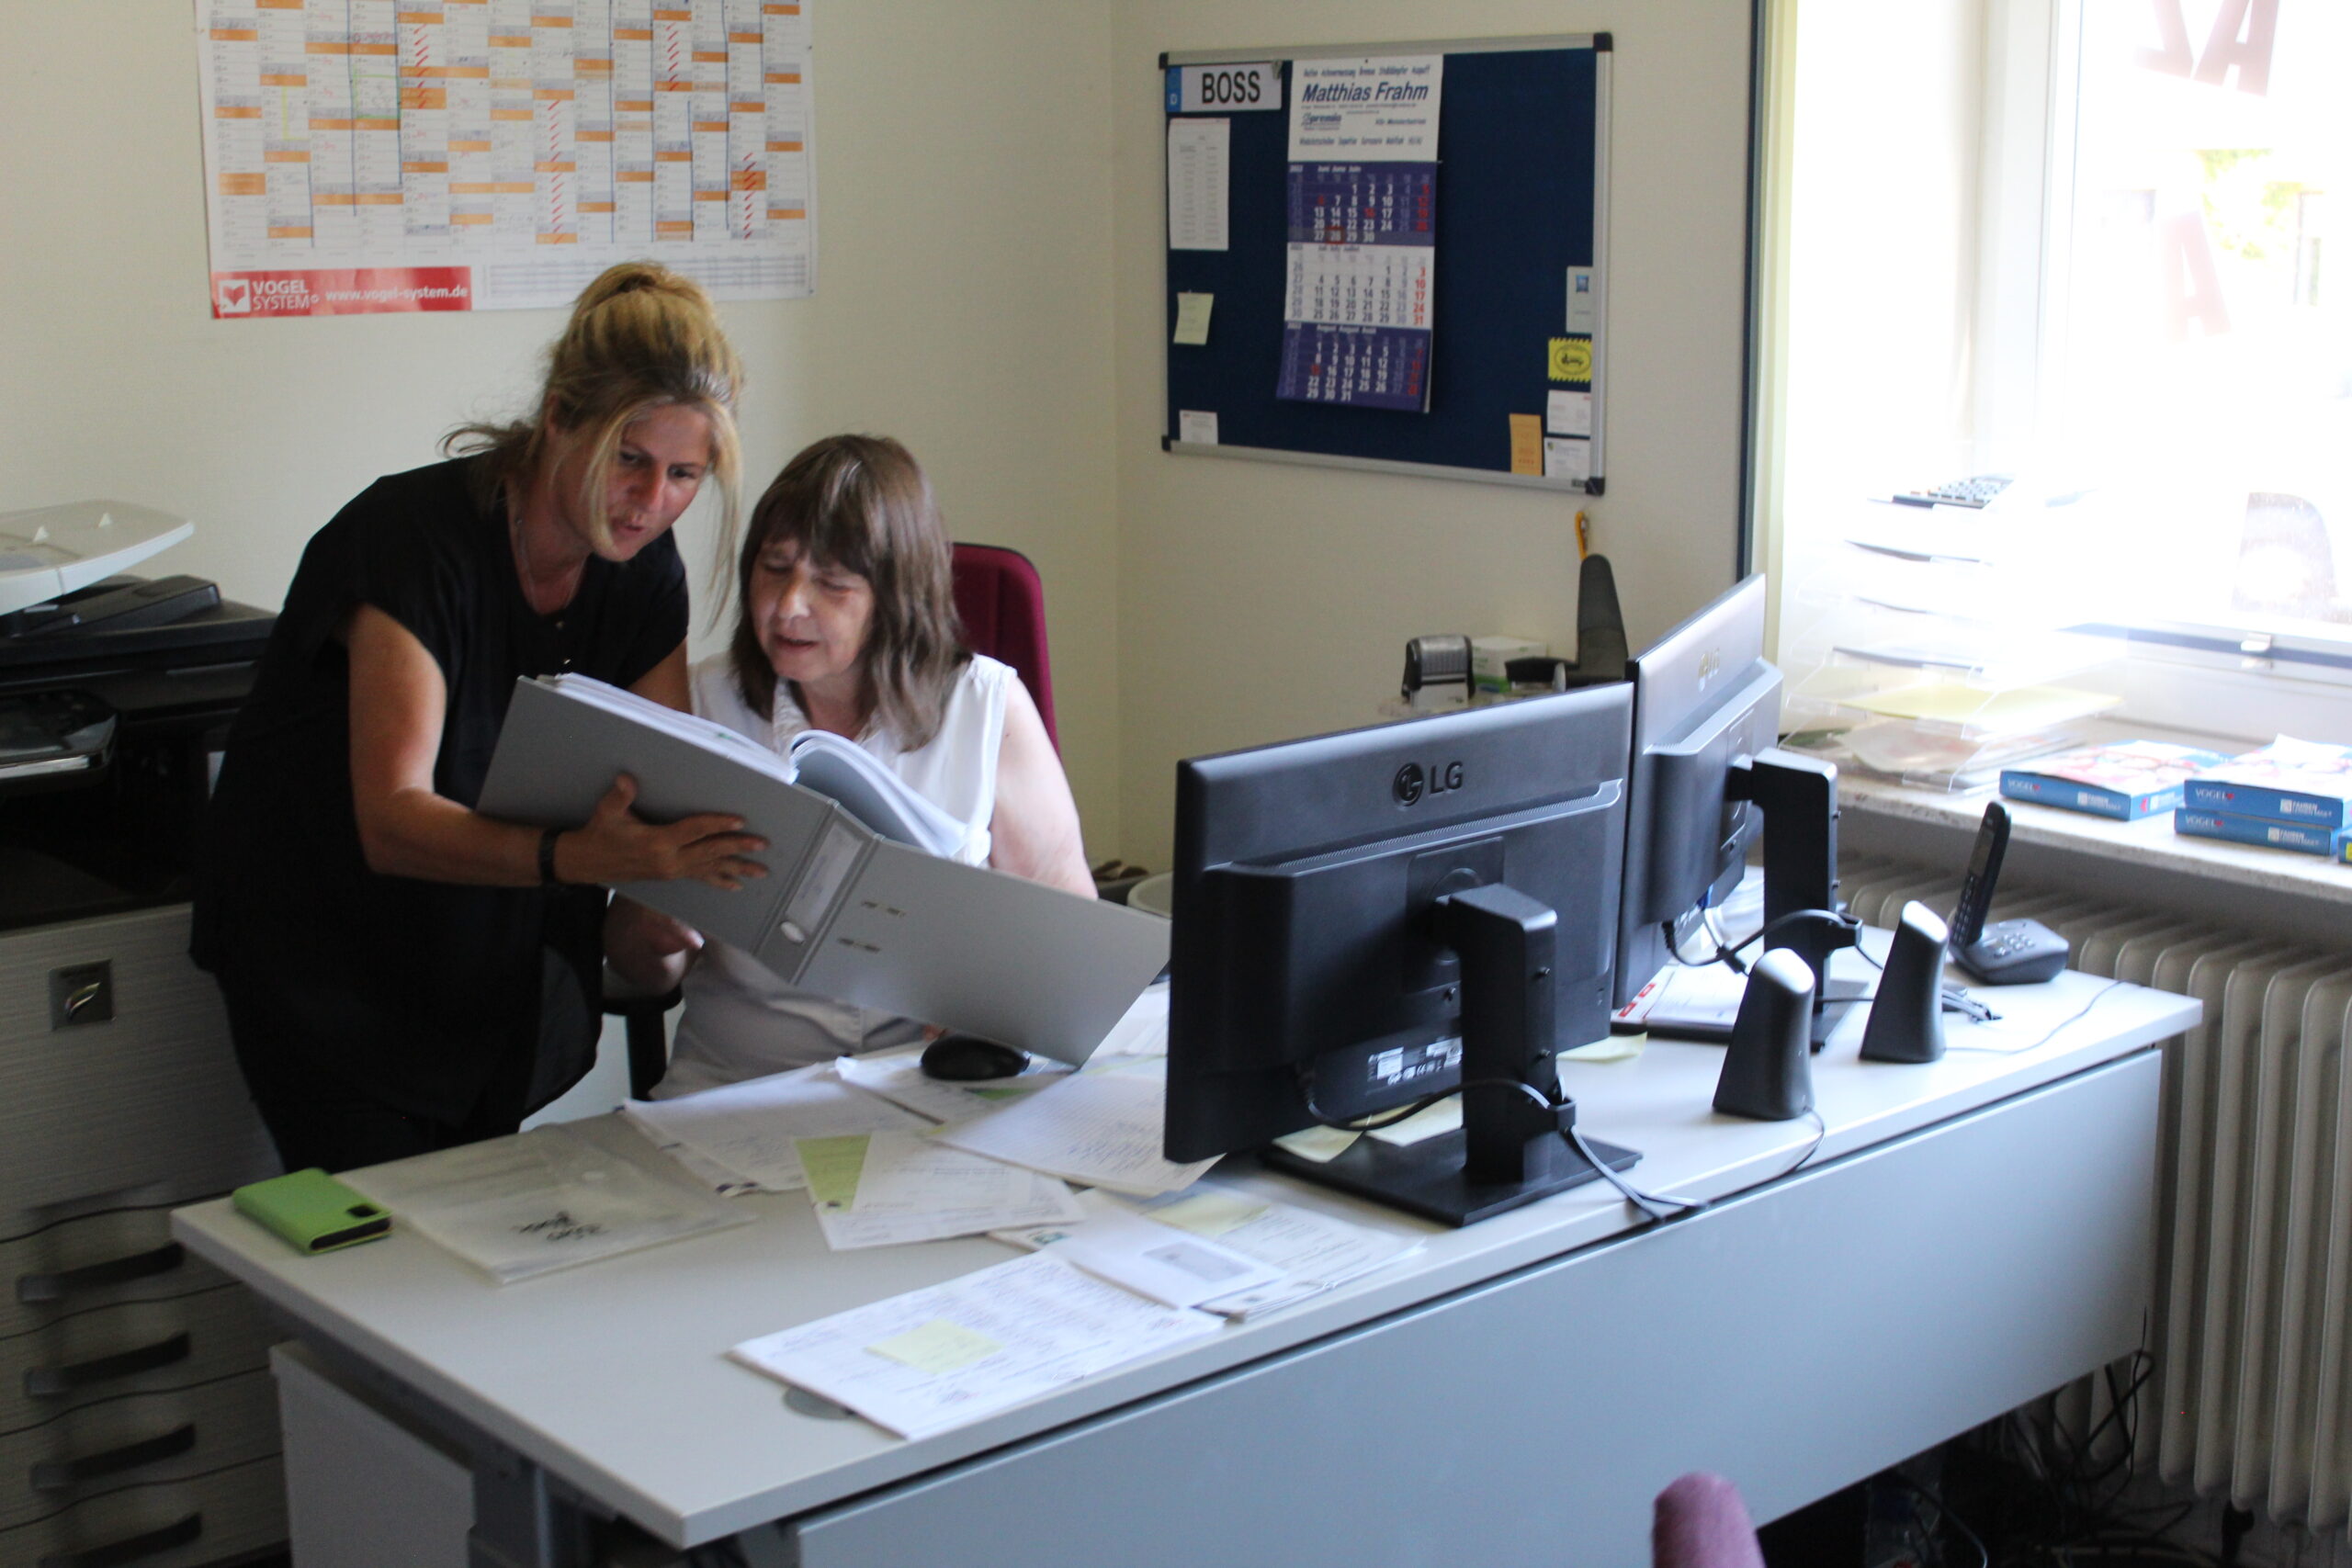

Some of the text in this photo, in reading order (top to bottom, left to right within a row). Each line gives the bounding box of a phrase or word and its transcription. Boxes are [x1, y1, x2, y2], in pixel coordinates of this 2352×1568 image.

[1203, 71, 1261, 103] BOSS
[1303, 81, 1429, 102] Matthias Frahm
[1352, 184, 1357, 194] 1
[1370, 184, 1375, 194] 2
[1388, 184, 1393, 195] 3
[1335, 195, 1340, 205] 7
[1352, 196, 1357, 206] 8
[1369, 196, 1375, 207] 9
[1382, 197, 1393, 207] 10
[1315, 207, 1324, 217] 13
[1331, 208, 1340, 218] 14
[1348, 208, 1357, 218] 15
[1382, 208, 1393, 219] 17
[1315, 219, 1324, 229] 20
[1347, 220, 1357, 230] 22
[1363, 220, 1374, 230] 23
[1381, 220, 1392, 231] 24
[1315, 231, 1374, 243] 27 28 29 30
[253, 279, 309, 294] VOGEL
[325, 285, 468, 301] www.vogel-system.de
[1430, 761, 1464, 795] LG
[2196, 788, 2226, 801] VOGEL
[2185, 816, 2215, 827] VOGEL
